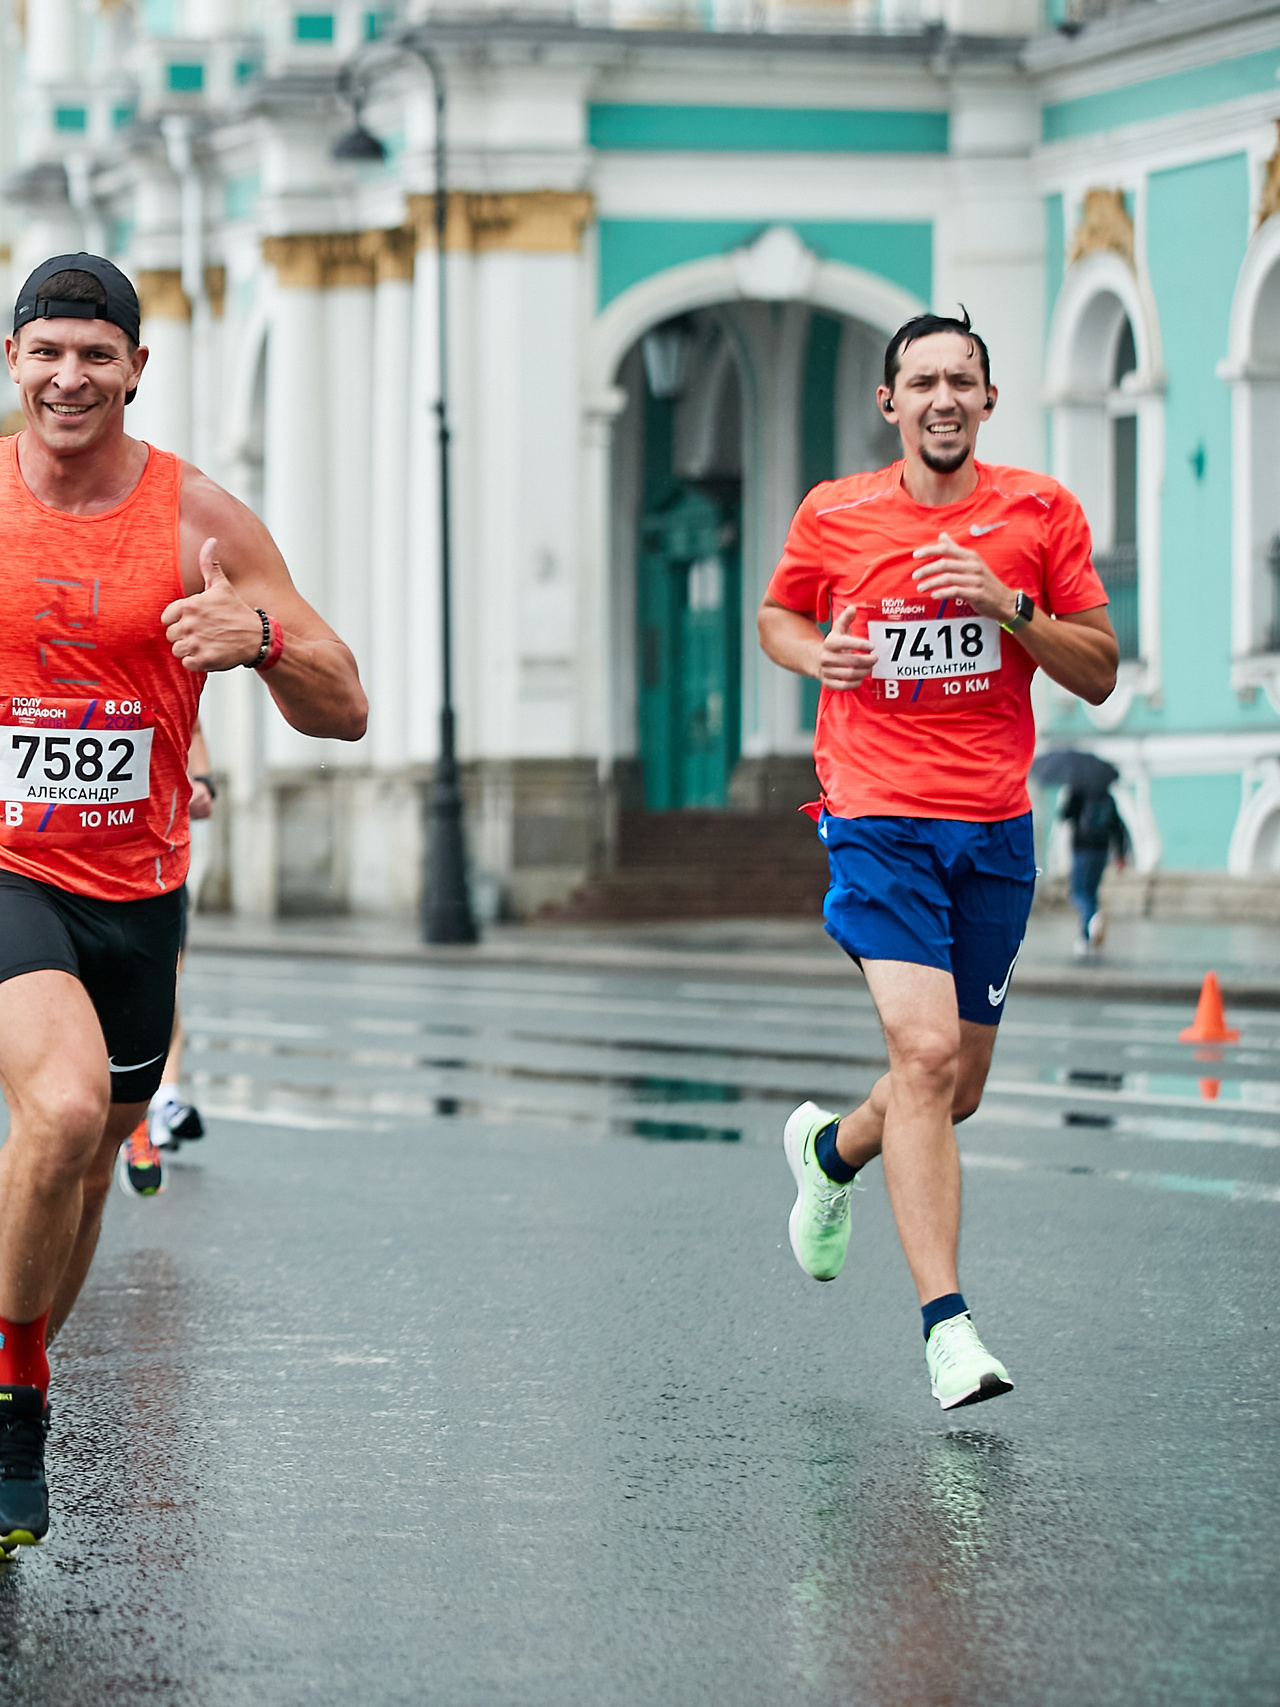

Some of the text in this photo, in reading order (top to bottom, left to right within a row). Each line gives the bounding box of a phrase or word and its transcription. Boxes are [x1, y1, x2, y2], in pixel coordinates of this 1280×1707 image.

[885, 623, 983, 662] 7418
[897, 662, 976, 676] КОНСТАНТИН
[943, 681, 961, 695] 10
[12, 697, 41, 707] ПОЛУ
[104, 700, 141, 715] 8.08
[12, 707, 66, 718] МАРАФОН
[104, 716, 141, 729] 2021
[11, 734, 135, 782] 7582
[26, 785, 119, 802] АЛЕКСАНДР
[79, 811, 102, 827] 10
